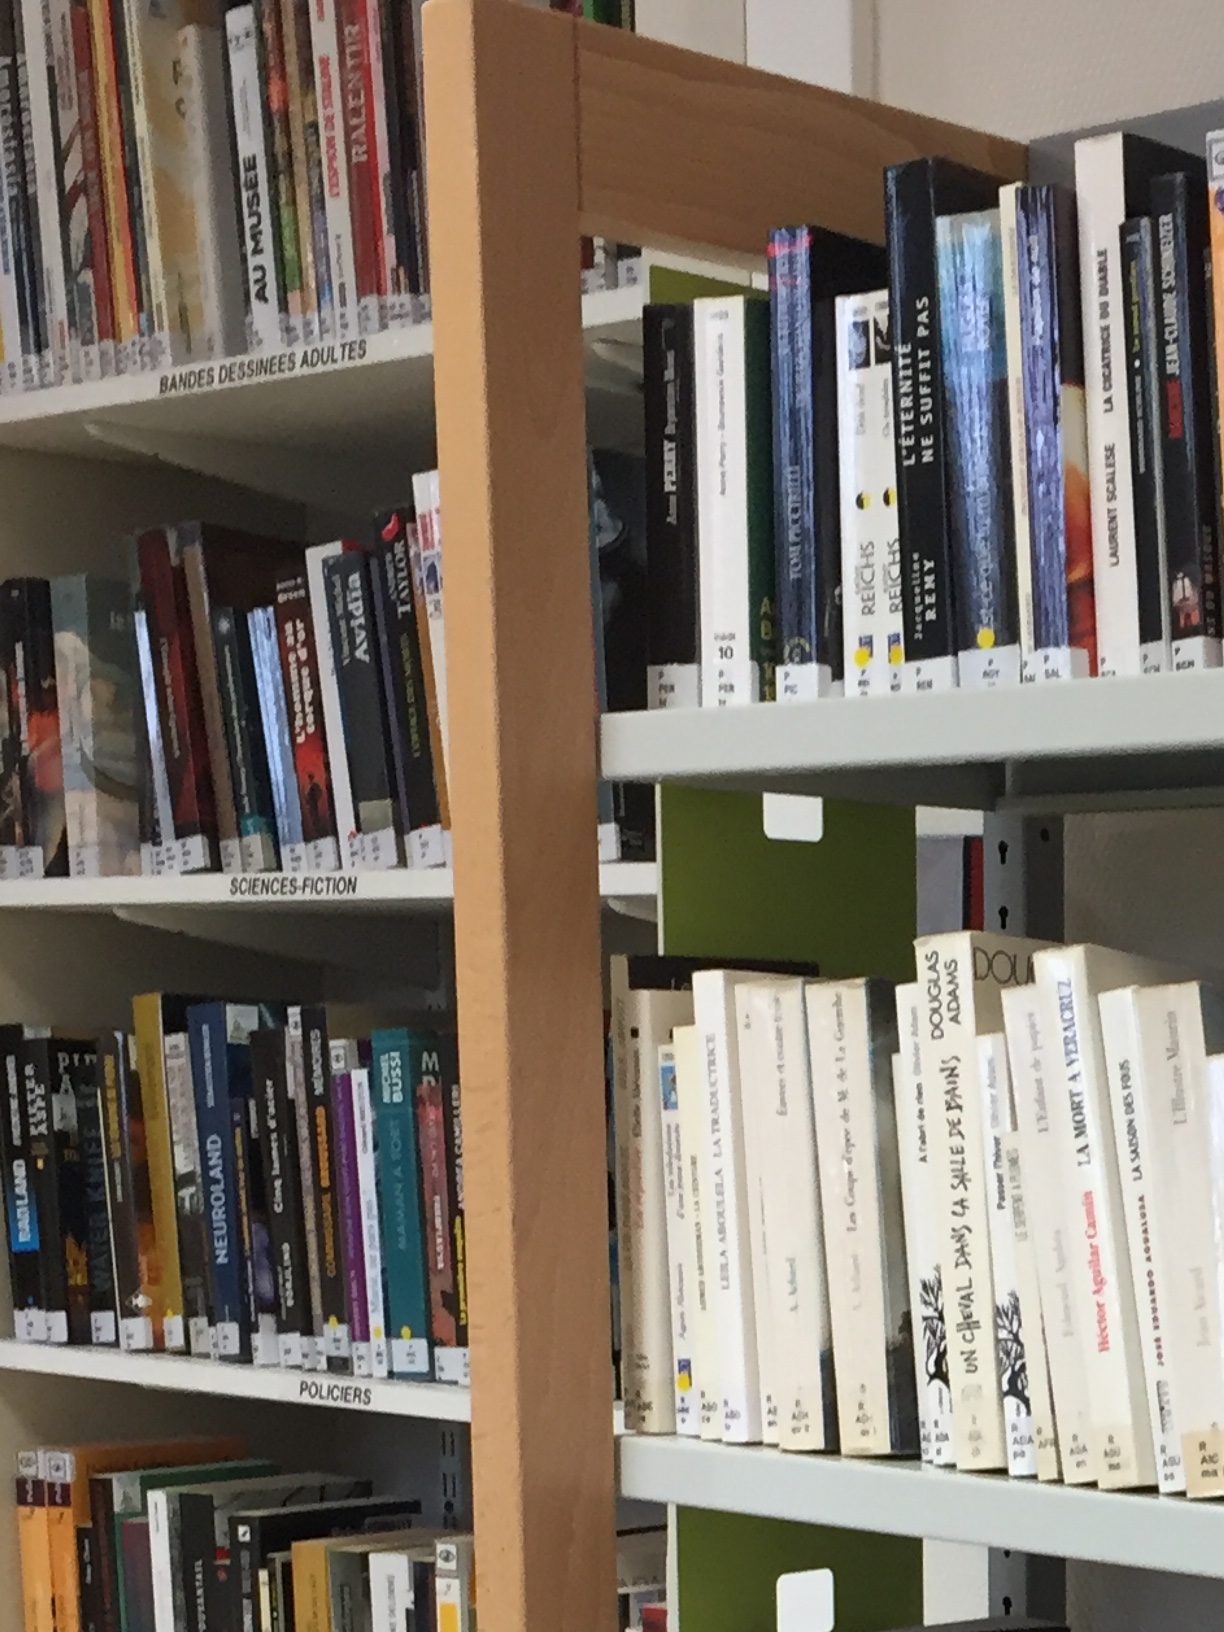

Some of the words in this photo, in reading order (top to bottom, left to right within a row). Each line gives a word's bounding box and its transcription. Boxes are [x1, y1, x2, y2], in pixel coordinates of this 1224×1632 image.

[242, 153, 265, 256] MUSÉE
[251, 264, 269, 304] AU
[1095, 248, 1110, 297] DIABLE
[915, 296, 929, 336] PAS
[1098, 301, 1110, 320] DU
[159, 367, 214, 395] BANDES
[218, 352, 296, 383] DESSINEES
[300, 340, 367, 369] ADULTES
[918, 347, 932, 426] SUFFIT
[1098, 323, 1113, 392] CICATRICE
[898, 342, 915, 466] L'ÉTERNITÉ
[1102, 396, 1114, 414] LA
[919, 433, 935, 463] NE
[1103, 443, 1118, 502] SCALESE
[1106, 507, 1120, 567] LAURENT
[859, 540, 875, 615] REICHS
[910, 551, 923, 640] Jacqueline
[922, 558, 936, 621] REMY
[925, 950, 945, 1040] DOUGLAS
[943, 958, 961, 1026] ADAMS
[1056, 977, 1081, 1066] VERACRUZ
[390, 1051, 403, 1103] BUSSI
[1068, 1070, 1082, 1083] A
[1069, 1088, 1089, 1139] MORT
[1076, 1145, 1092, 1167] LA
[206, 1133, 229, 1264] NEUROLAND
[299, 1380, 372, 1406] POLICIERS
